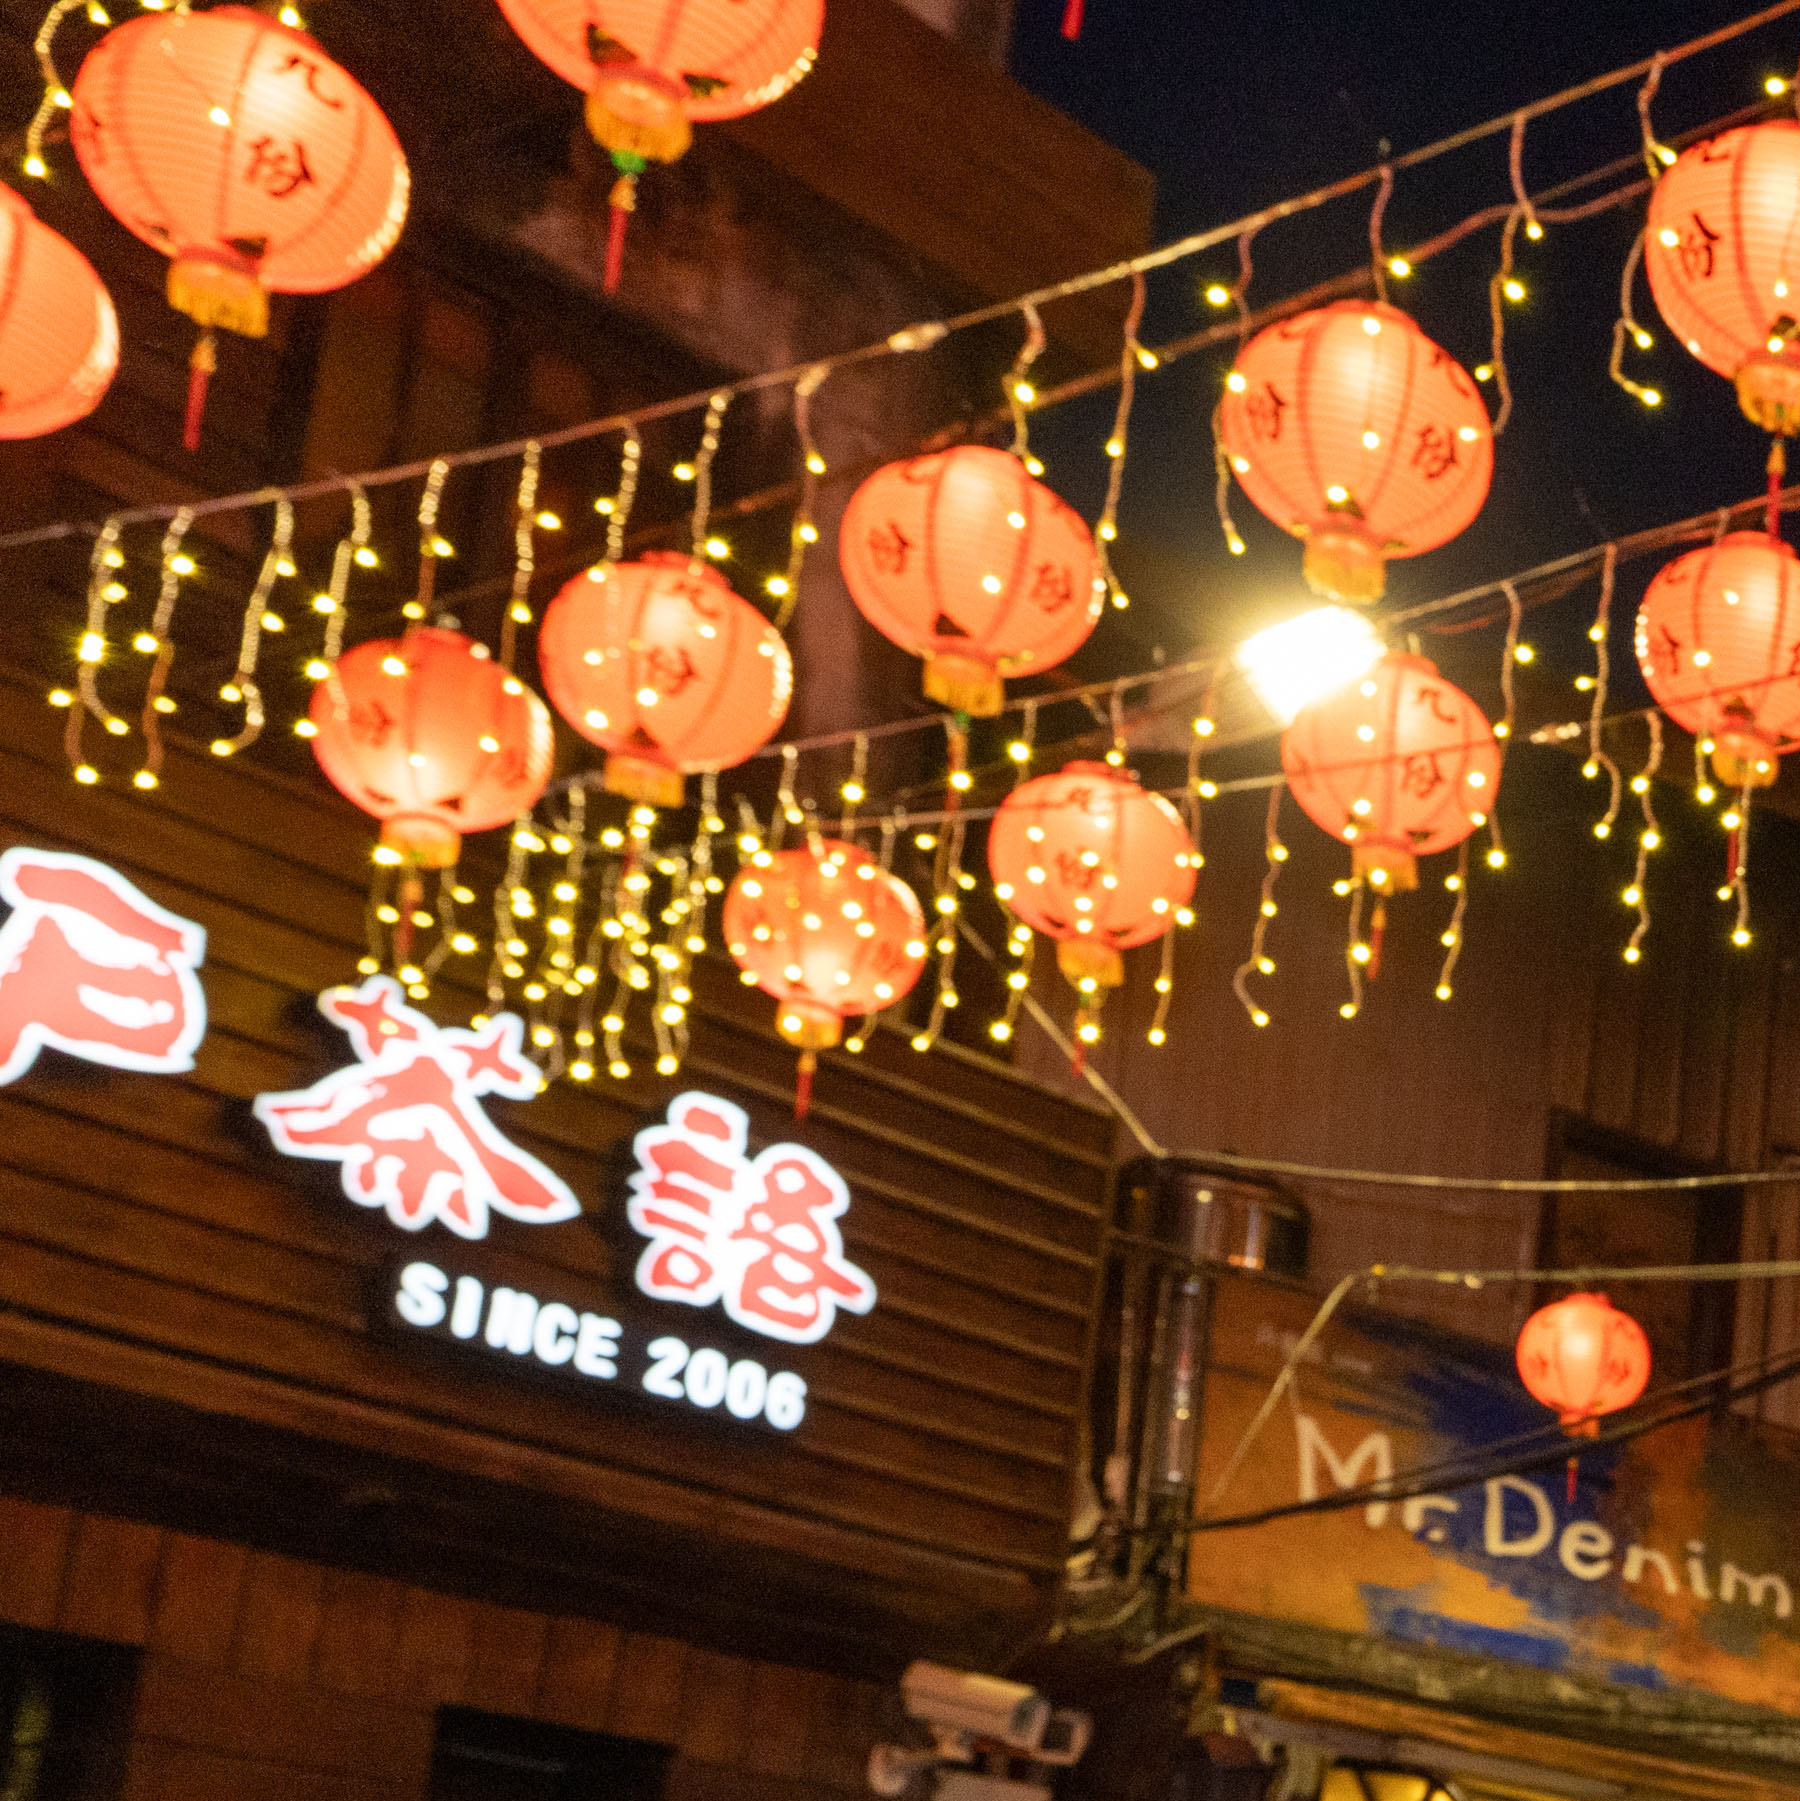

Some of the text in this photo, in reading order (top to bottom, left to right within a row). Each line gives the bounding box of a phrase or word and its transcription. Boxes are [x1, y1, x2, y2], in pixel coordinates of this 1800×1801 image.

[396, 1261, 807, 1431] SINCE 2006
[1295, 1412, 1460, 1542] Mr.
[1484, 1474, 1793, 1619] Denim
